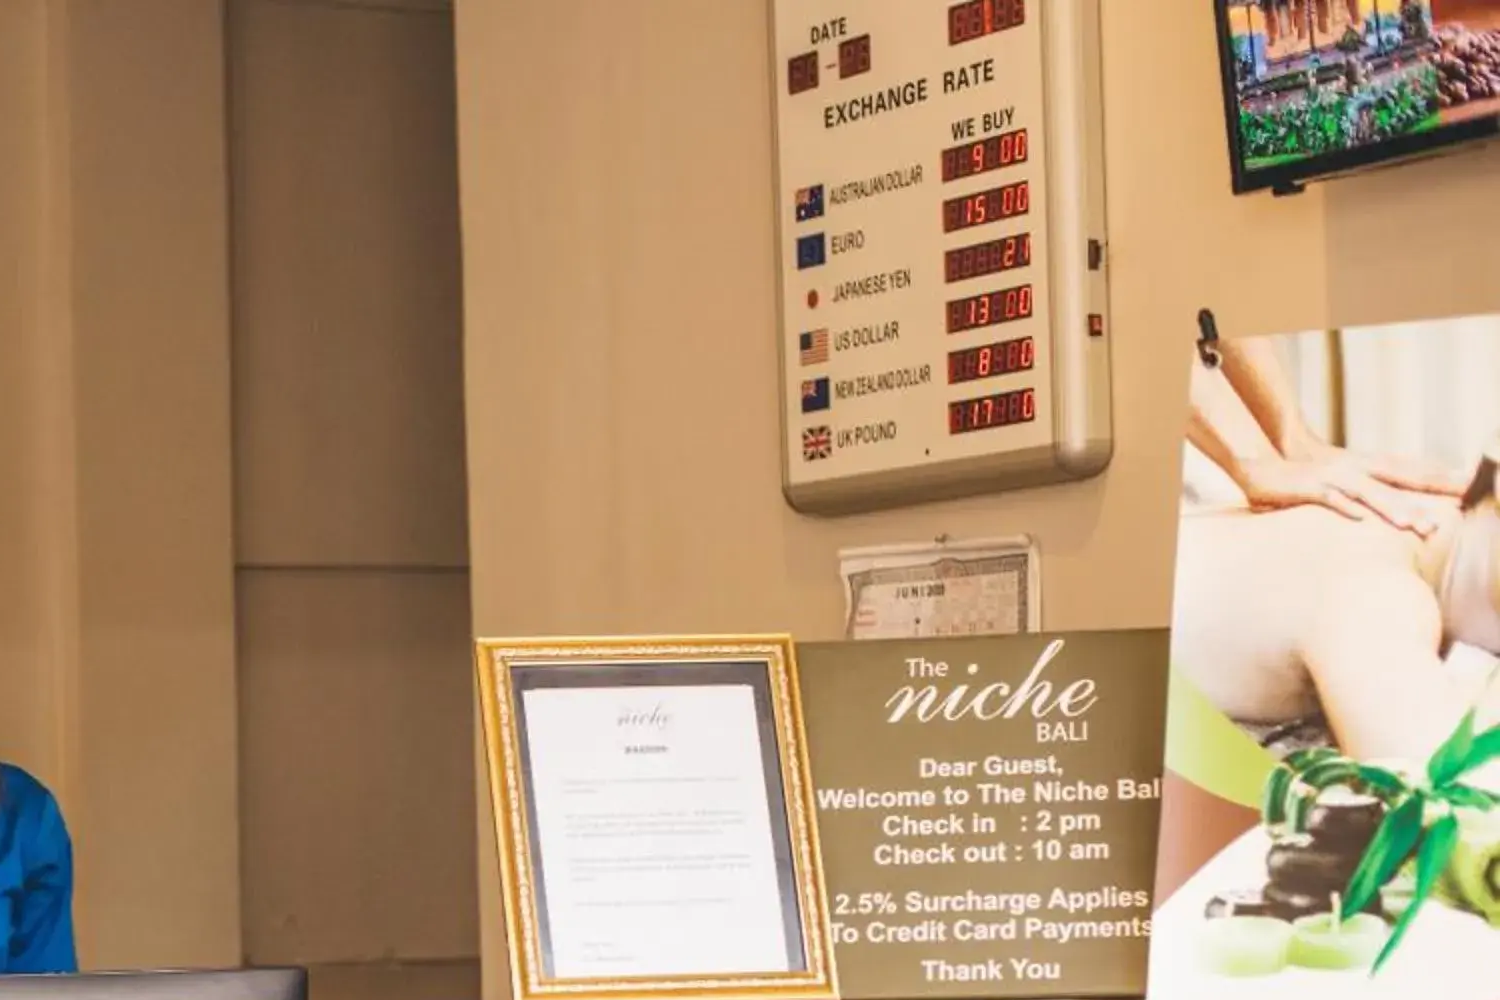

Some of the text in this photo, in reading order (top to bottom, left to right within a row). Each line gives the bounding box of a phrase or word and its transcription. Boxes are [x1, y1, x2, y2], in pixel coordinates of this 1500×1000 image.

[810, 17, 847, 45] DATE
[823, 58, 995, 129] EXCHANGE RATE
[951, 106, 1016, 142] WE BUY
[886, 165, 924, 194] DOLLAR
[831, 229, 865, 255] EURO
[832, 268, 912, 303] JAPANESE YEN
[834, 320, 900, 352] US DOLLAR
[834, 363, 932, 399] NEW ZEALAND DOLLAR
[836, 420, 897, 449] UK POUND
[884, 639, 1099, 723] niche
[905, 656, 949, 678] The
[1036, 721, 1088, 743] BALI
[918, 755, 1065, 778] Dear Guest,
[817, 788, 937, 810] Welcome
[942, 788, 970, 807] to
[977, 783, 1026, 804] The
[1033, 779, 1109, 802] Niche
[882, 814, 965, 837] Check
[972, 812, 997, 833] in
[1036, 812, 1052, 831] 2
[1059, 812, 1102, 836] pm
[873, 843, 956, 866] Check
[963, 842, 1007, 864] out
[1032, 840, 1062, 861] 10
[1069, 840, 1111, 861] am
[834, 887, 1150, 915] 2.5% Surcharge Applies
[830, 916, 1154, 944] To Credit Card Payments
[921, 957, 1062, 982] Thank You
